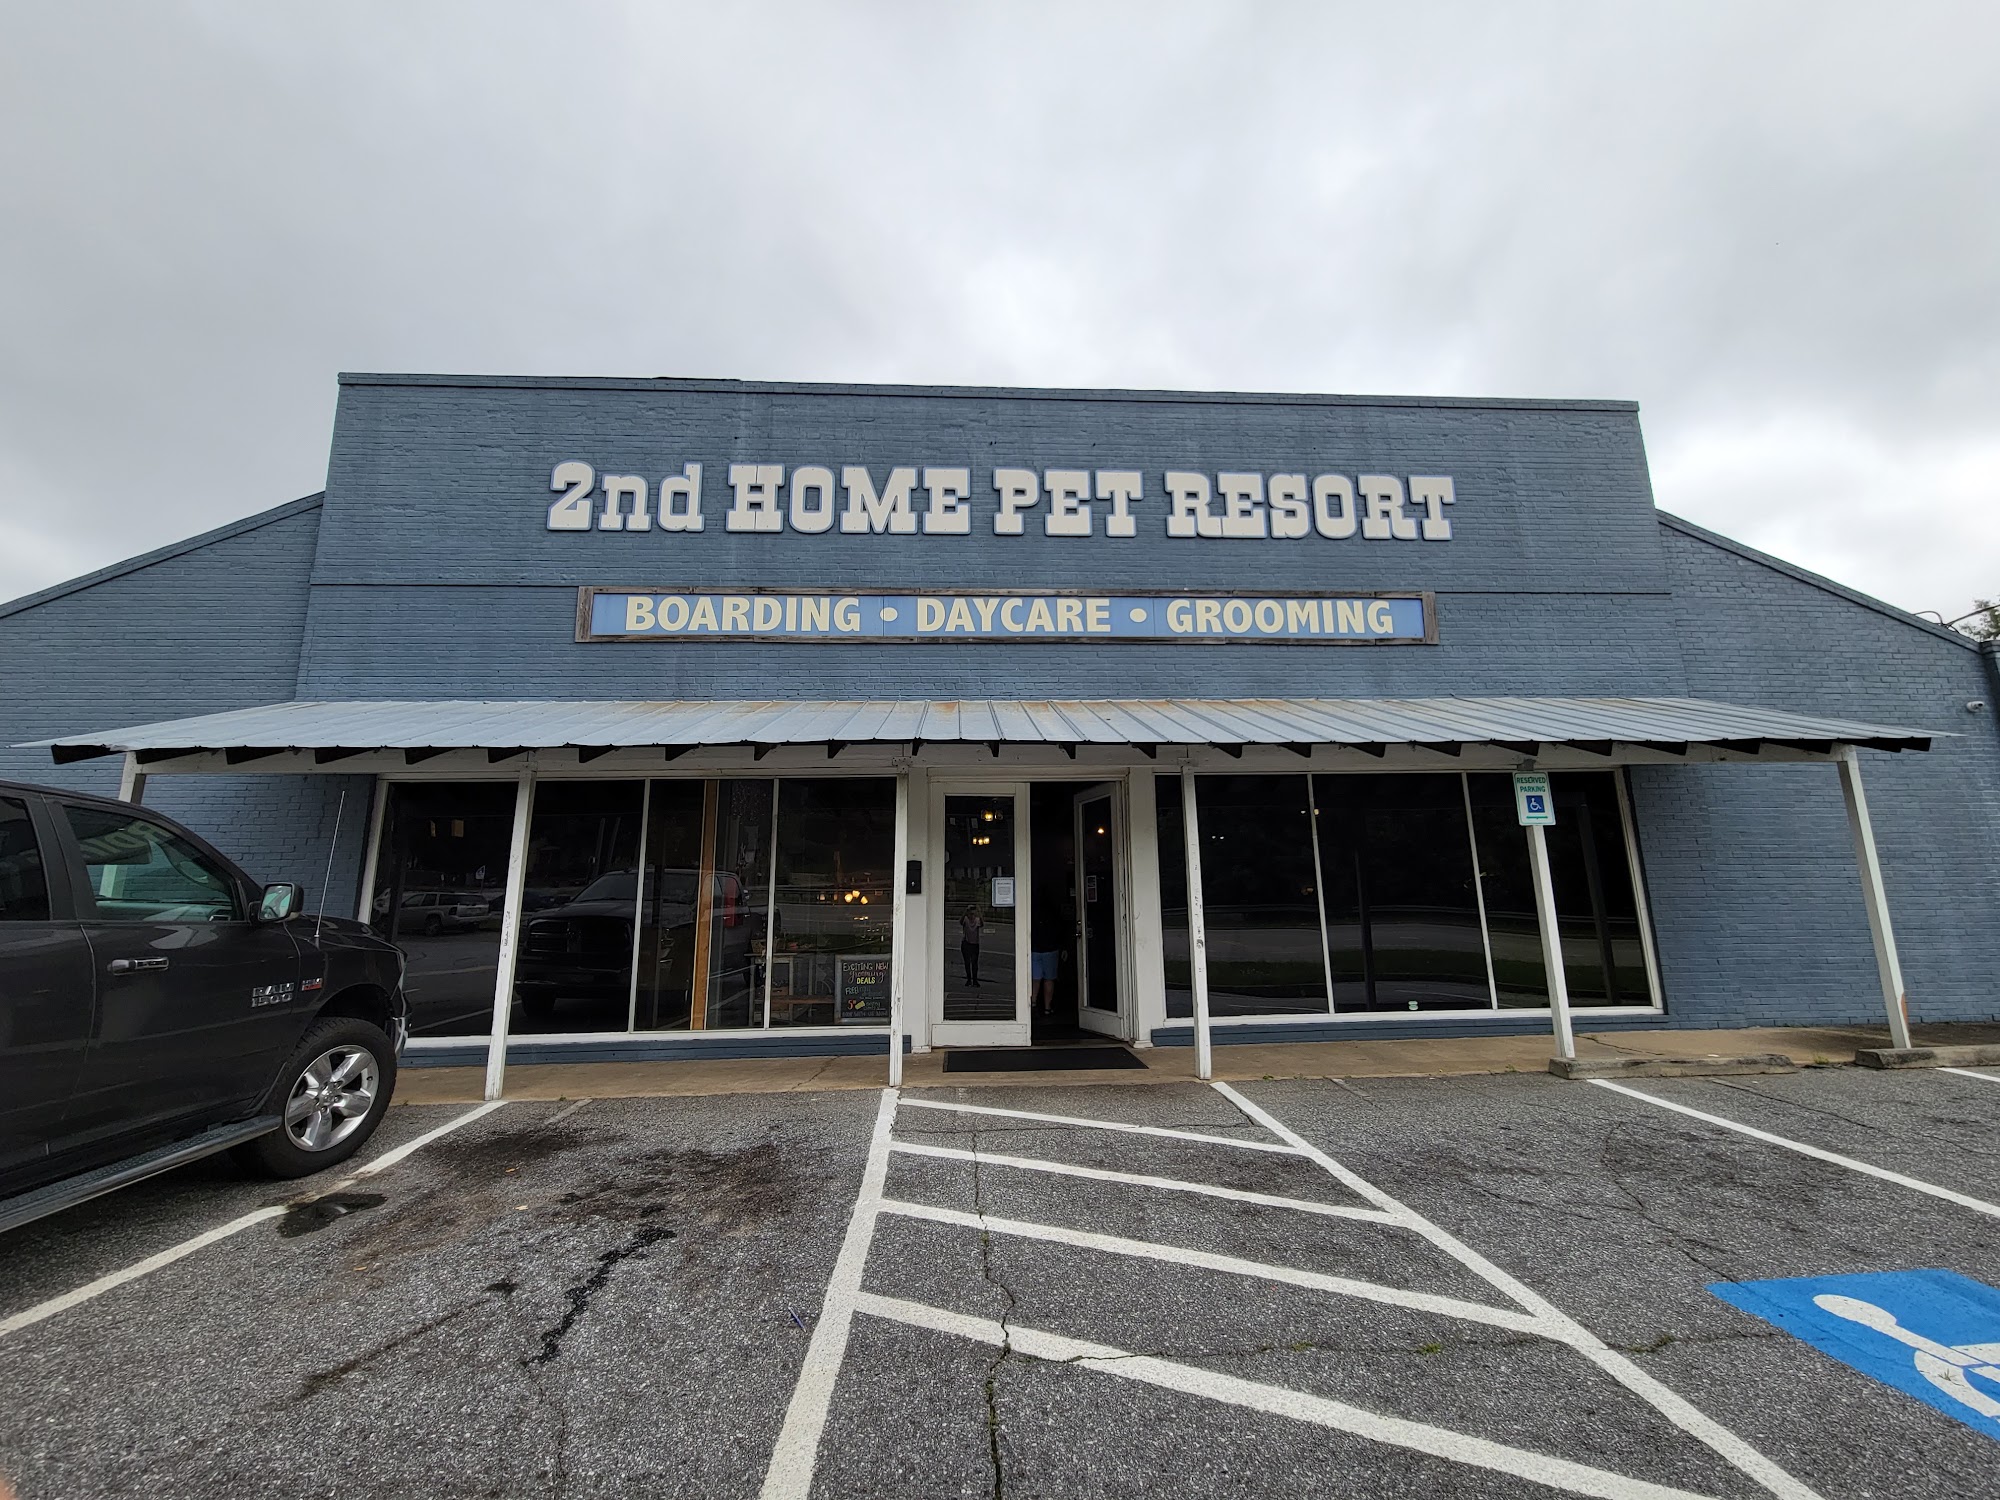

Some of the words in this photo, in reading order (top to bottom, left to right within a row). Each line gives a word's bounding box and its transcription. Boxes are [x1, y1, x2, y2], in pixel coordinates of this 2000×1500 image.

[547, 460, 704, 531] 2nd
[726, 463, 971, 534] HOME
[993, 468, 1144, 538] PET
[1164, 471, 1456, 541] RESORT
[625, 596, 861, 632] BOARDING
[917, 597, 1111, 633] DAYCARE
[1166, 600, 1393, 634] GROOMING
[876, 962, 888, 970] NEW
[253, 982, 294, 997] RAM
